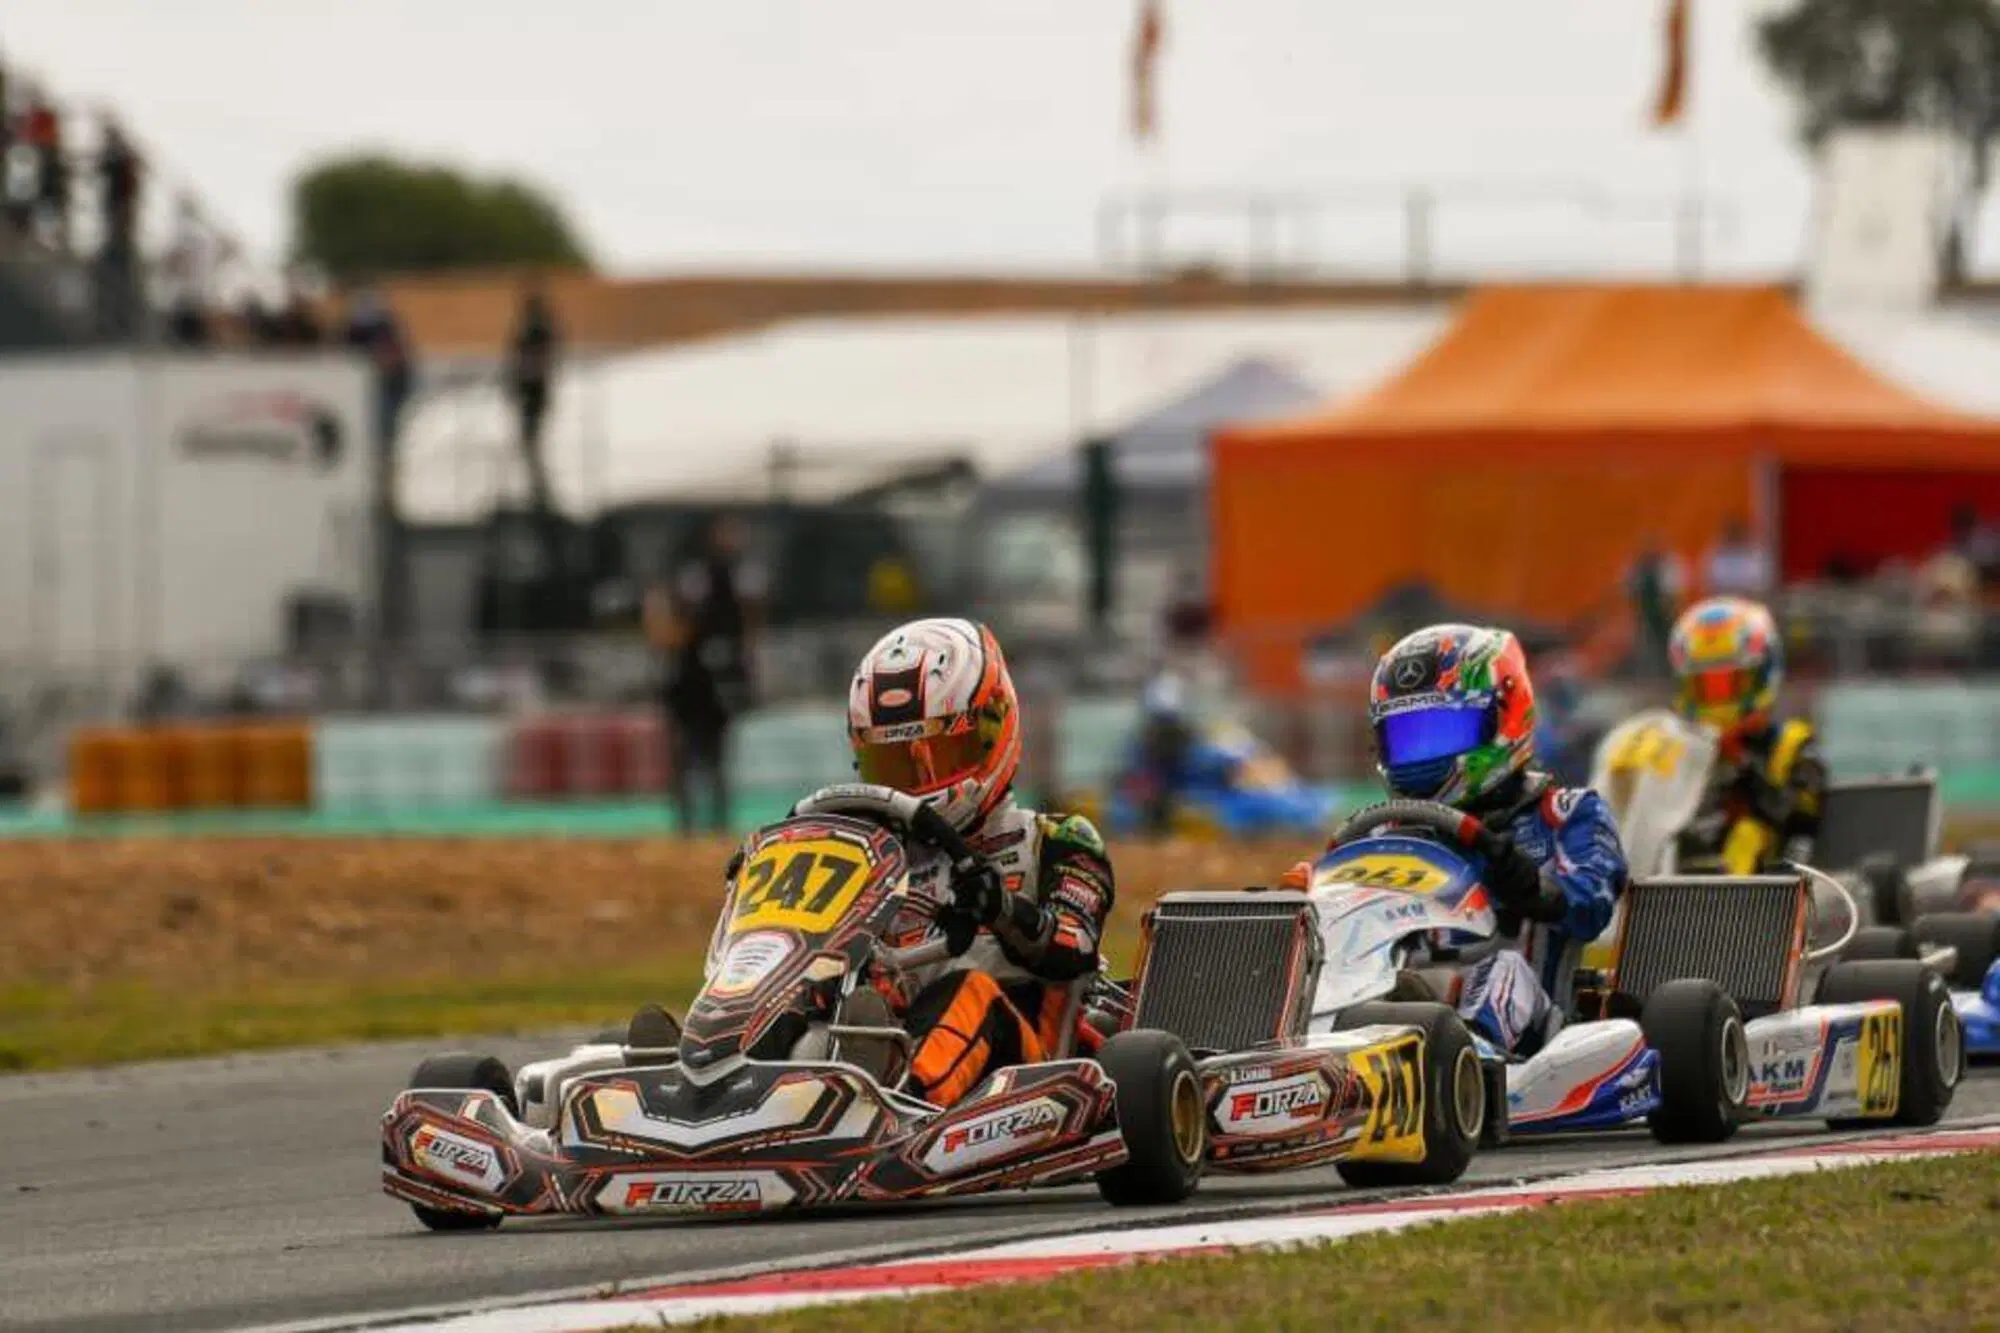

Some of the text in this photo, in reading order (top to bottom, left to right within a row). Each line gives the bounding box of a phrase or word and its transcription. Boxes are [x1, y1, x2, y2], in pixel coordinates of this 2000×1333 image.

[736, 851, 863, 918] 247
[1230, 1080, 1321, 1121] FORZA
[1364, 1040, 1420, 1141] 247
[943, 1103, 1056, 1153] FORZA
[414, 1131, 493, 1171] FORZA
[625, 1179, 761, 1207] FORZA
